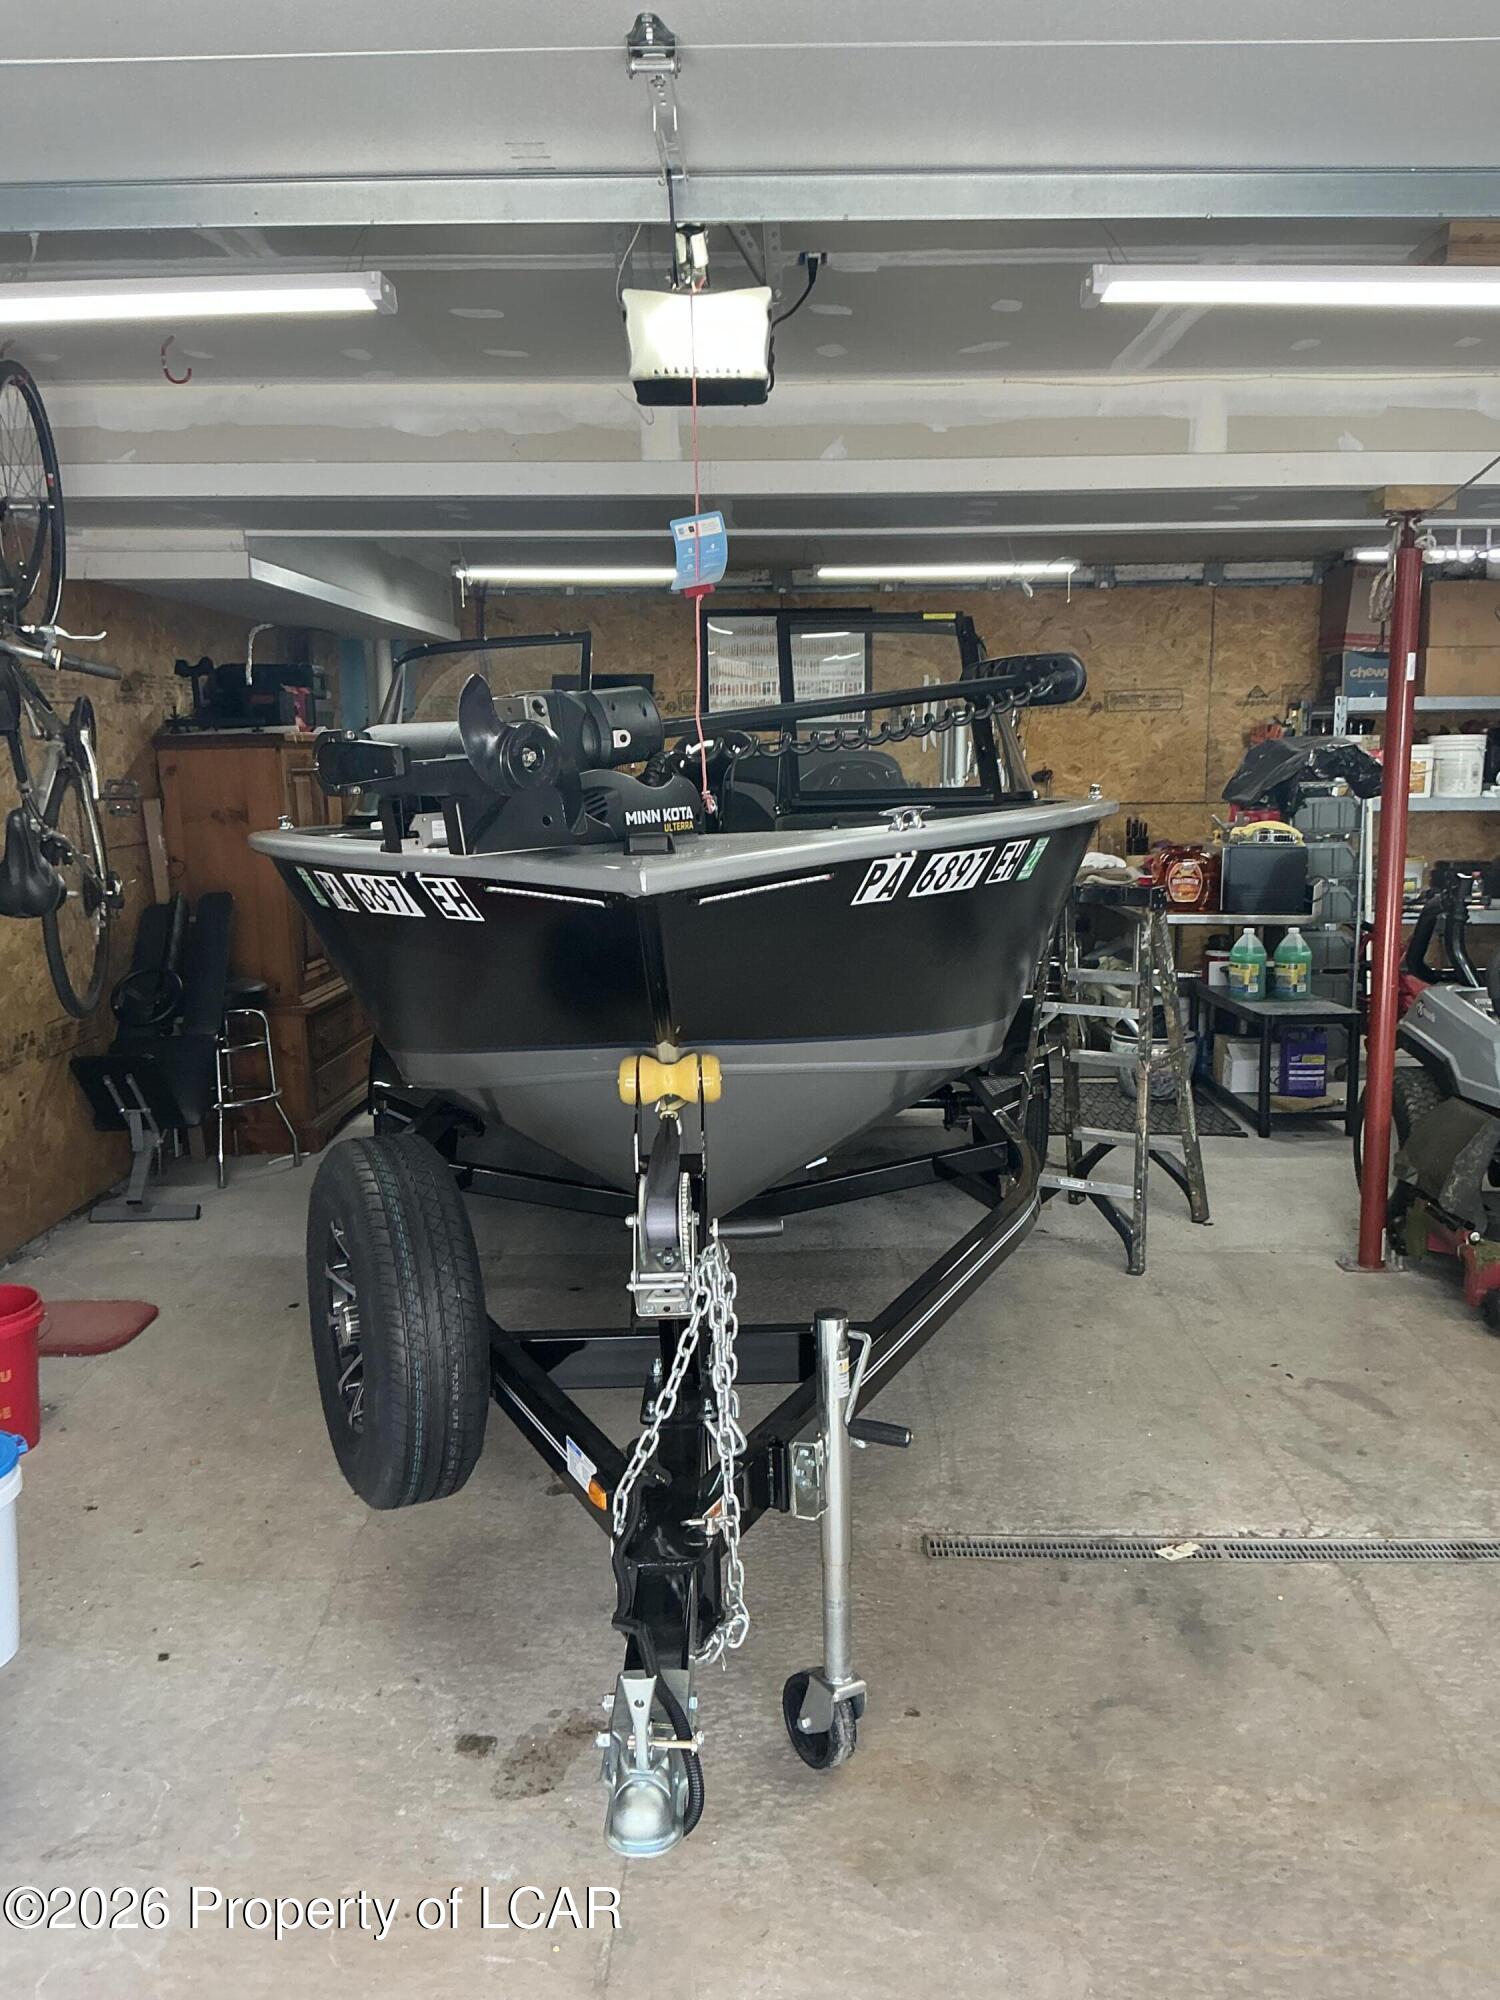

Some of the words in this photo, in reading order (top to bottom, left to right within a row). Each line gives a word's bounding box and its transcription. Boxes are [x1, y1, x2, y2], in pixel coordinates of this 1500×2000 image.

[625, 809, 661, 826] MINN
[662, 806, 694, 822] KOTA
[664, 821, 694, 832] ULTERRA
[855, 860, 907, 901] PA
[916, 851, 989, 894] 6897
[992, 841, 1028, 880] EH
[315, 873, 357, 910] PA
[350, 876, 414, 914] 6897
[422, 879, 482, 919] EH
